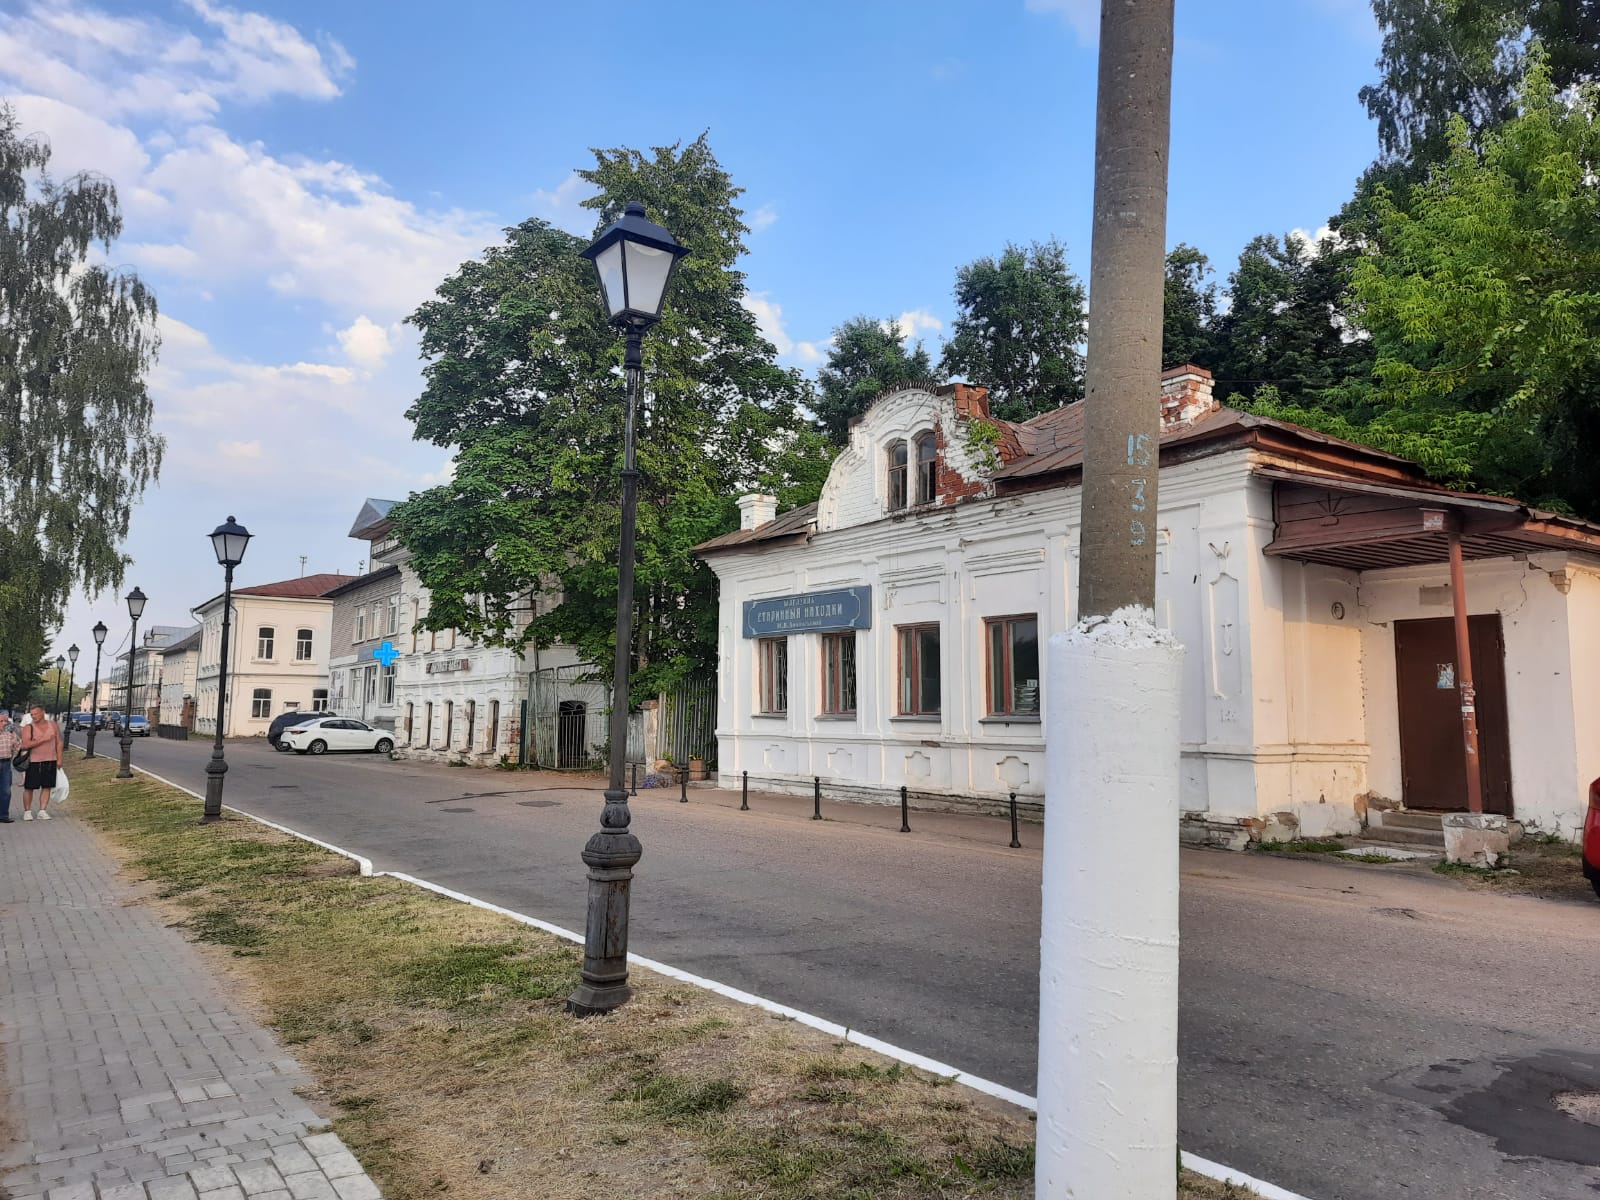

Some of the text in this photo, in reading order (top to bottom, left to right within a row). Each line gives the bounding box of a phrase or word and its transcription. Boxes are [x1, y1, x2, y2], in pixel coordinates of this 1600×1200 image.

[1127, 434, 1151, 465] 15
[1131, 479, 1147, 512] 3
[1130, 519, 1146, 546] 9
[804, 603, 843, 618] НАХОДКИ
